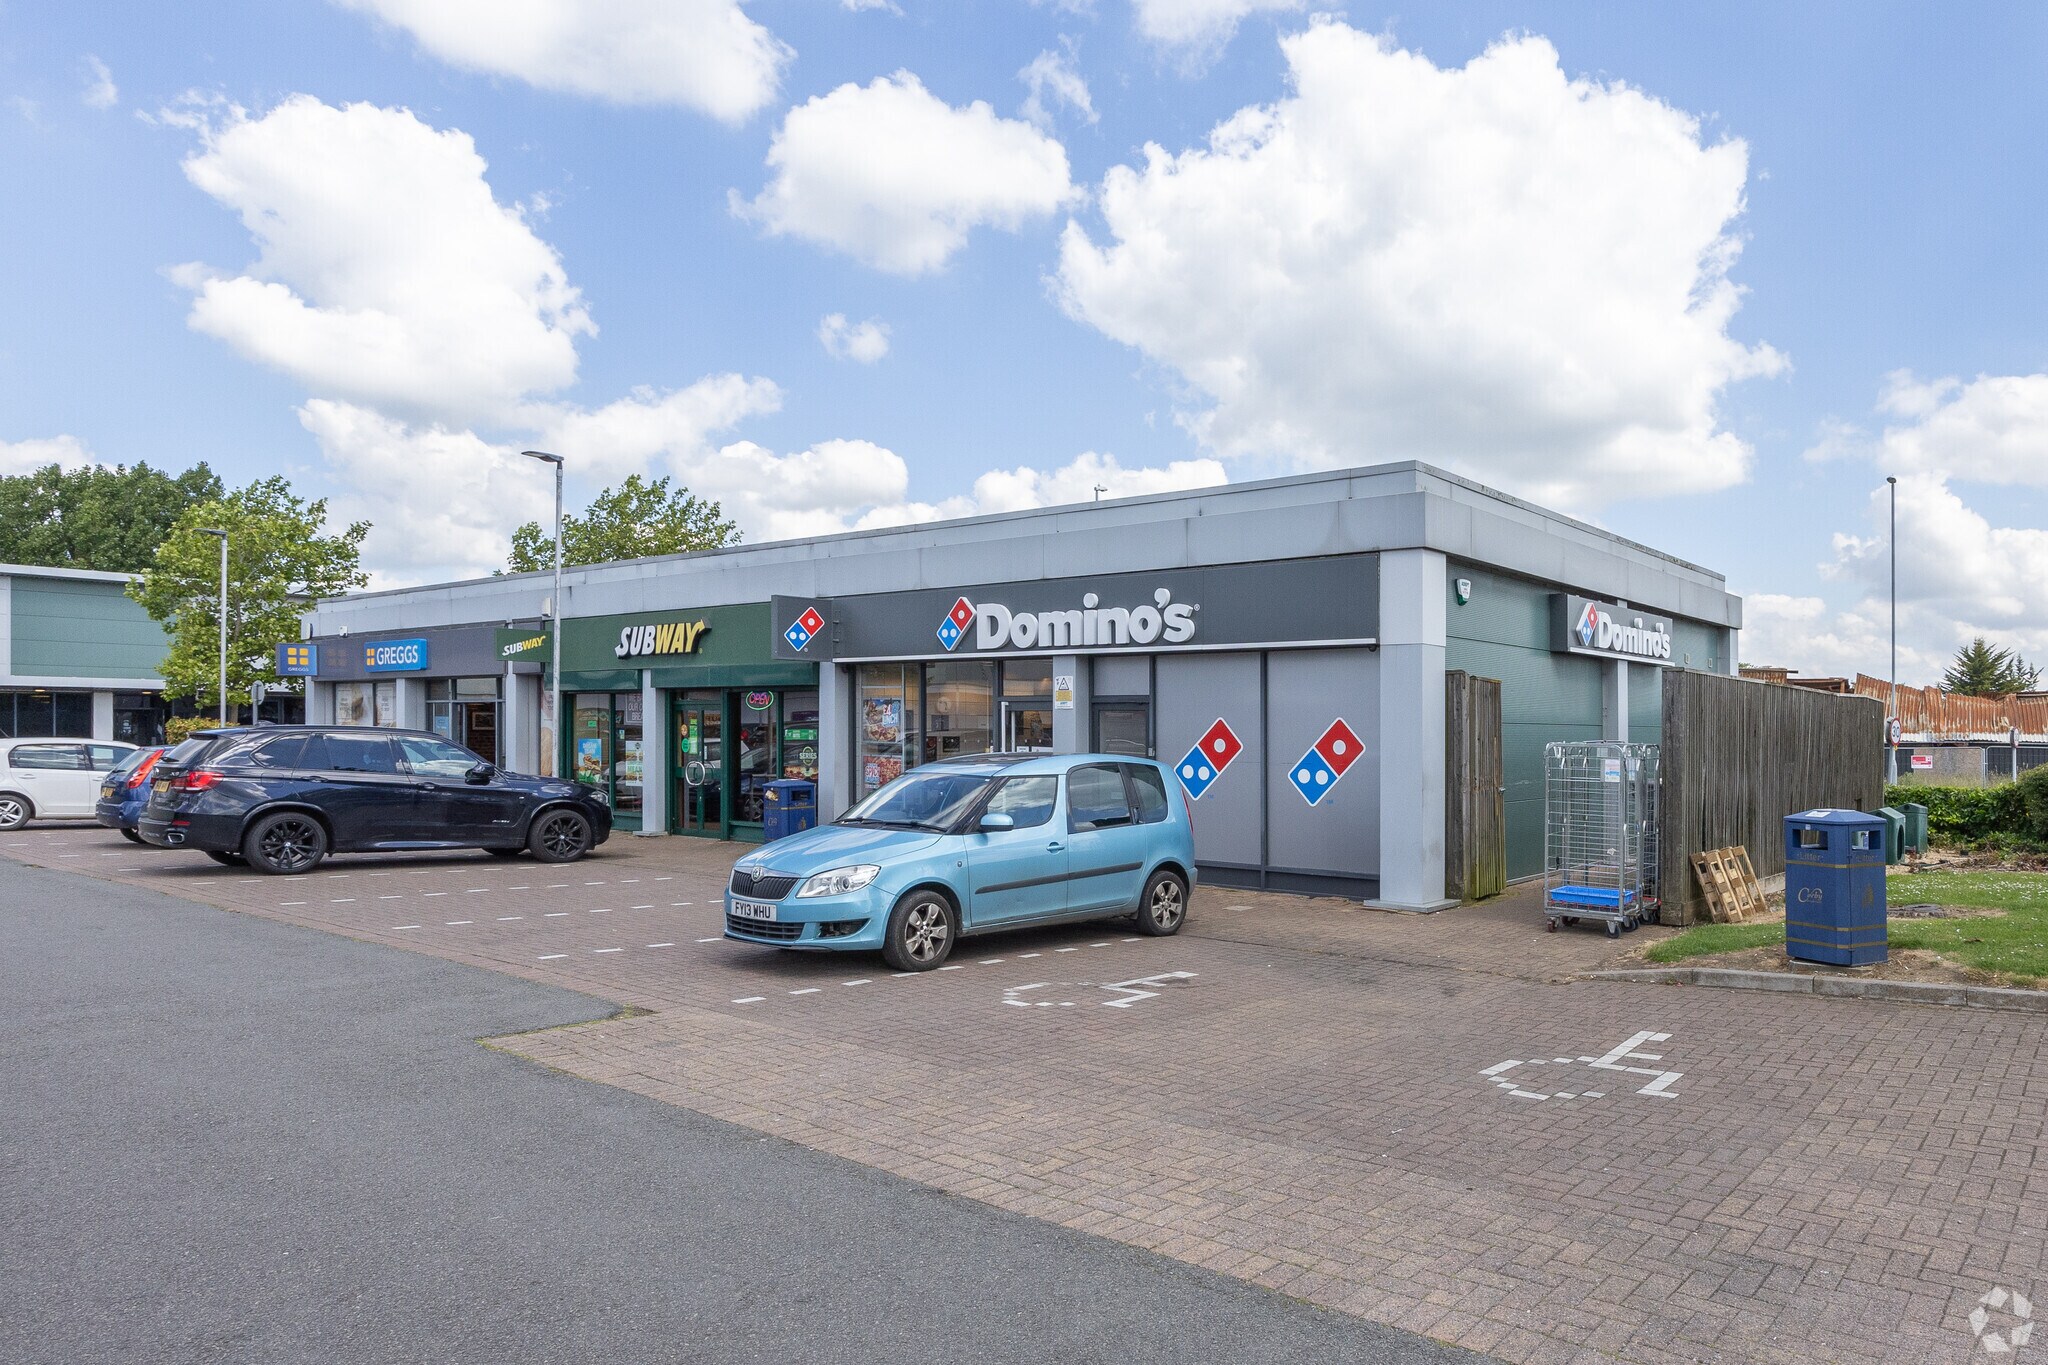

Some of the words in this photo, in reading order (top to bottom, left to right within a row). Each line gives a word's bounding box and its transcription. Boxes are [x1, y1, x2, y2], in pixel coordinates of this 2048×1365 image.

[976, 588, 1196, 650] Domino's
[502, 635, 547, 656] SUBWAY
[614, 618, 707, 659] SUBWAY
[1595, 612, 1671, 658] Domino's
[376, 645, 419, 666] GREGGS
[749, 692, 771, 705] OPEN
[1892, 725, 1900, 738] 30
[735, 902, 751, 915] FY13
[754, 905, 770, 918] WHU
